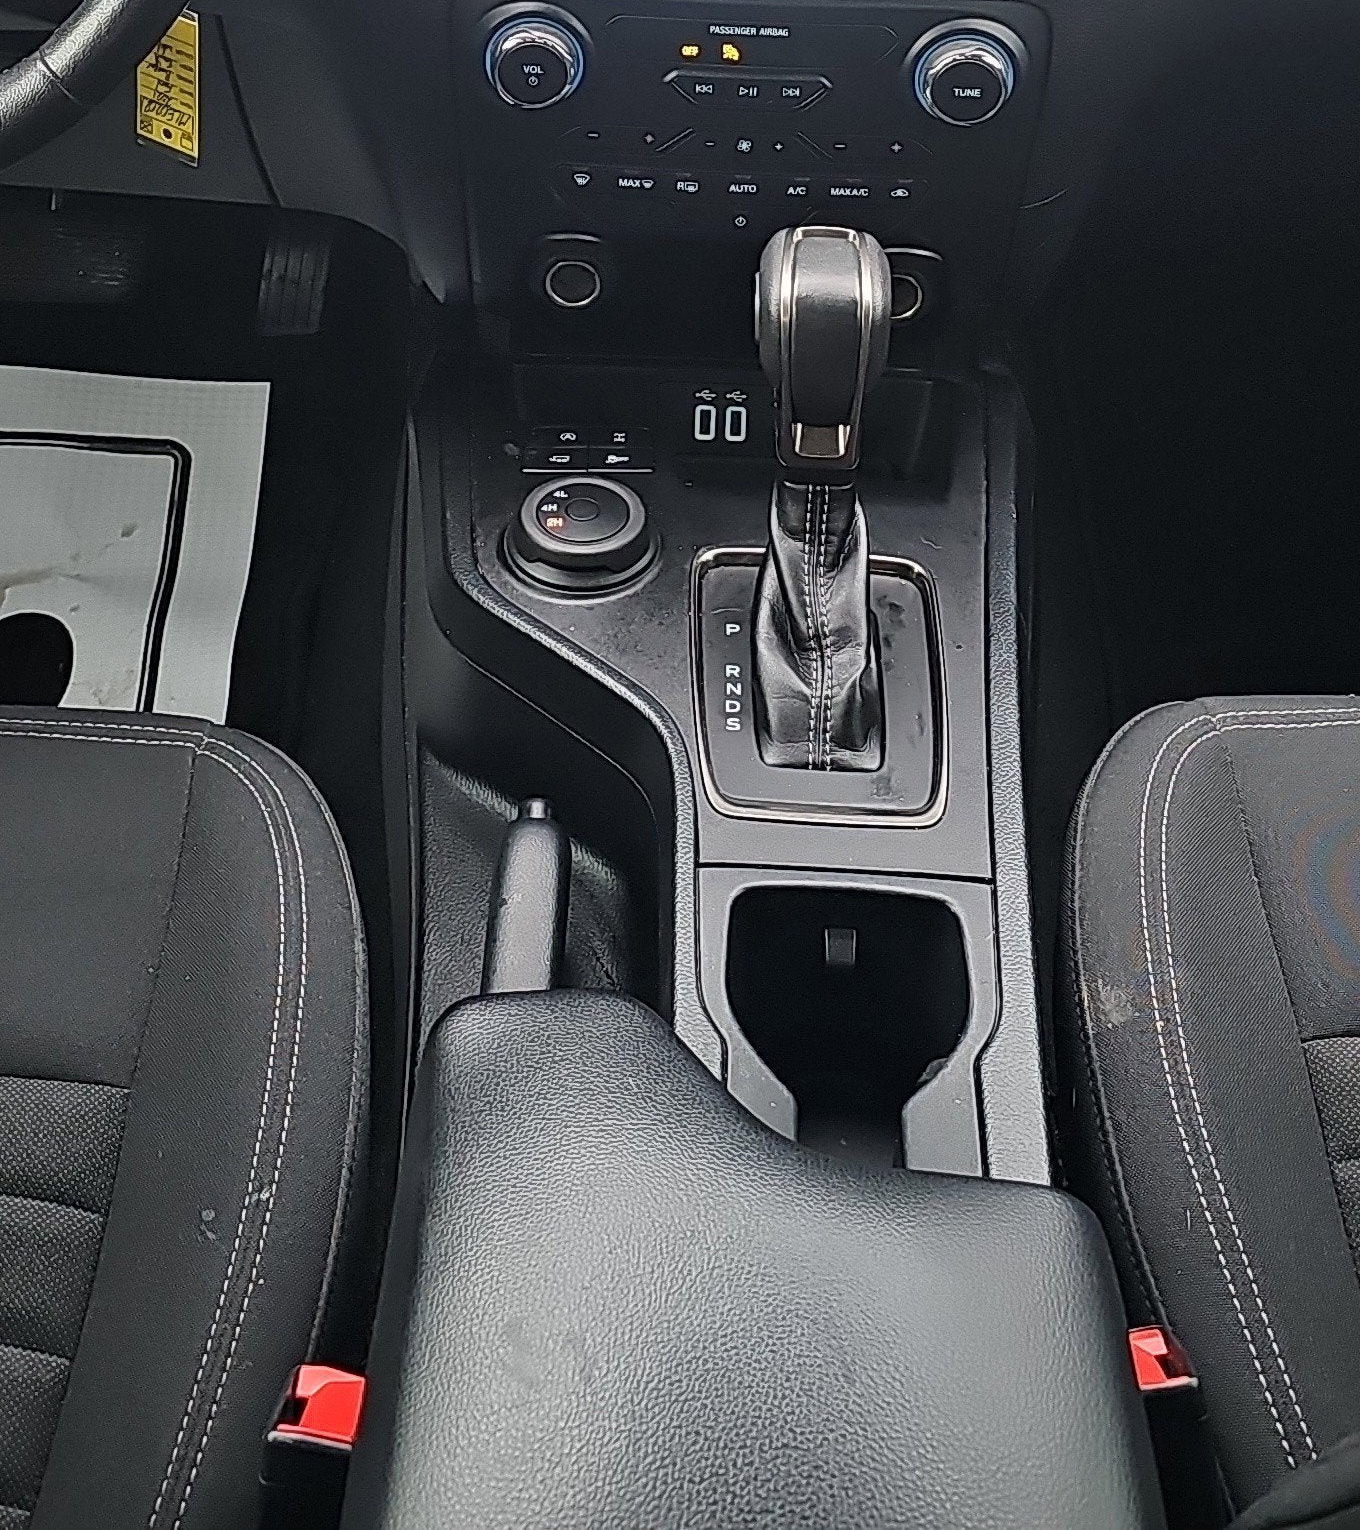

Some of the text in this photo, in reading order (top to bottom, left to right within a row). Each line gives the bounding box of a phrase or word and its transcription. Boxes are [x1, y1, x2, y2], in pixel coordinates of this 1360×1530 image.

[709, 25, 789, 37] PASSENGER AIRBAG
[523, 65, 544, 74] VOL
[952, 88, 982, 98] TUNE
[618, 178, 641, 188] MAX
[728, 183, 757, 194] AUTO
[786, 186, 807, 196] A/C
[553, 490, 569, 498] 4L
[540, 503, 558, 512] 4H
[546, 517, 563, 528] 2H
[725, 623, 741, 636] P
[725, 664, 740, 678] R
[726, 682, 742, 696] N
[725, 699, 741, 713] D
[725, 717, 741, 731] S
